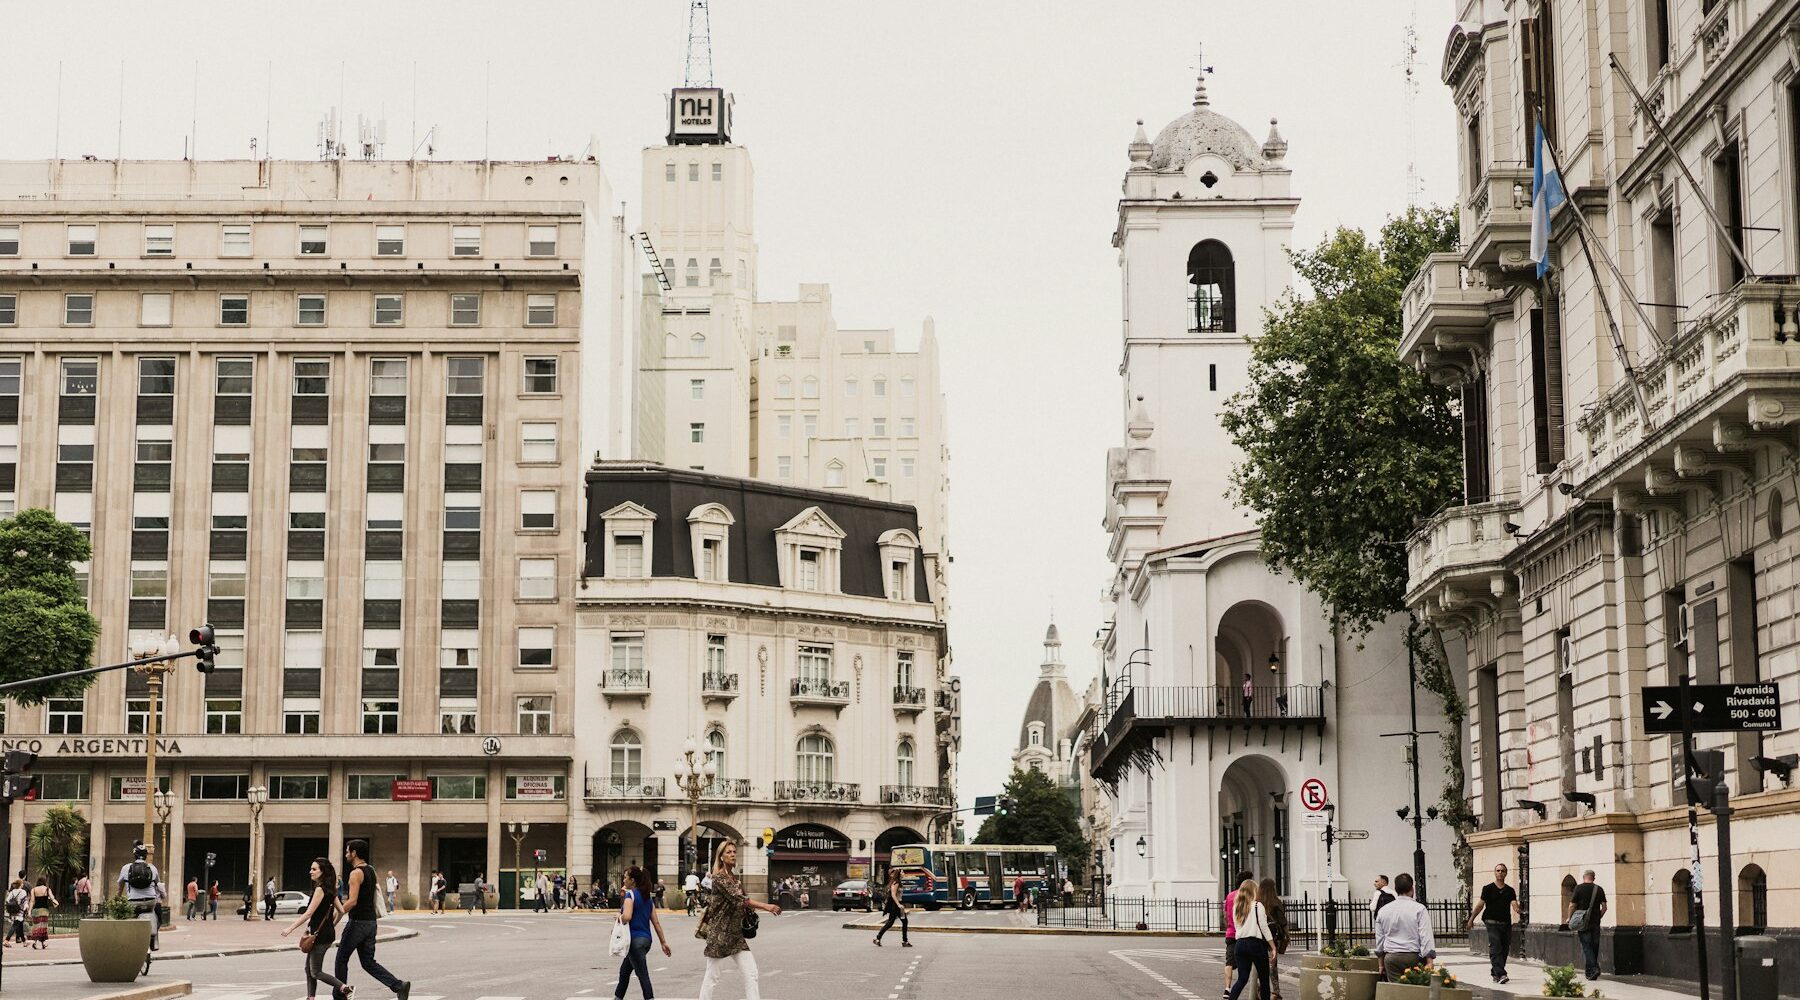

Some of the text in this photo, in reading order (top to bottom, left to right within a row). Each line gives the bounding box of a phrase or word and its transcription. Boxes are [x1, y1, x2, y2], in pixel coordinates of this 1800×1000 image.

[1733, 684, 1775, 695] Avenida
[1726, 695, 1776, 707] Rivadavia
[951, 679, 961, 751] CITY
[1730, 709, 1750, 719] 500
[1757, 708, 1777, 718] 600
[57, 739, 182, 754] ARGENTINA
[786, 837, 803, 849] GRAN
